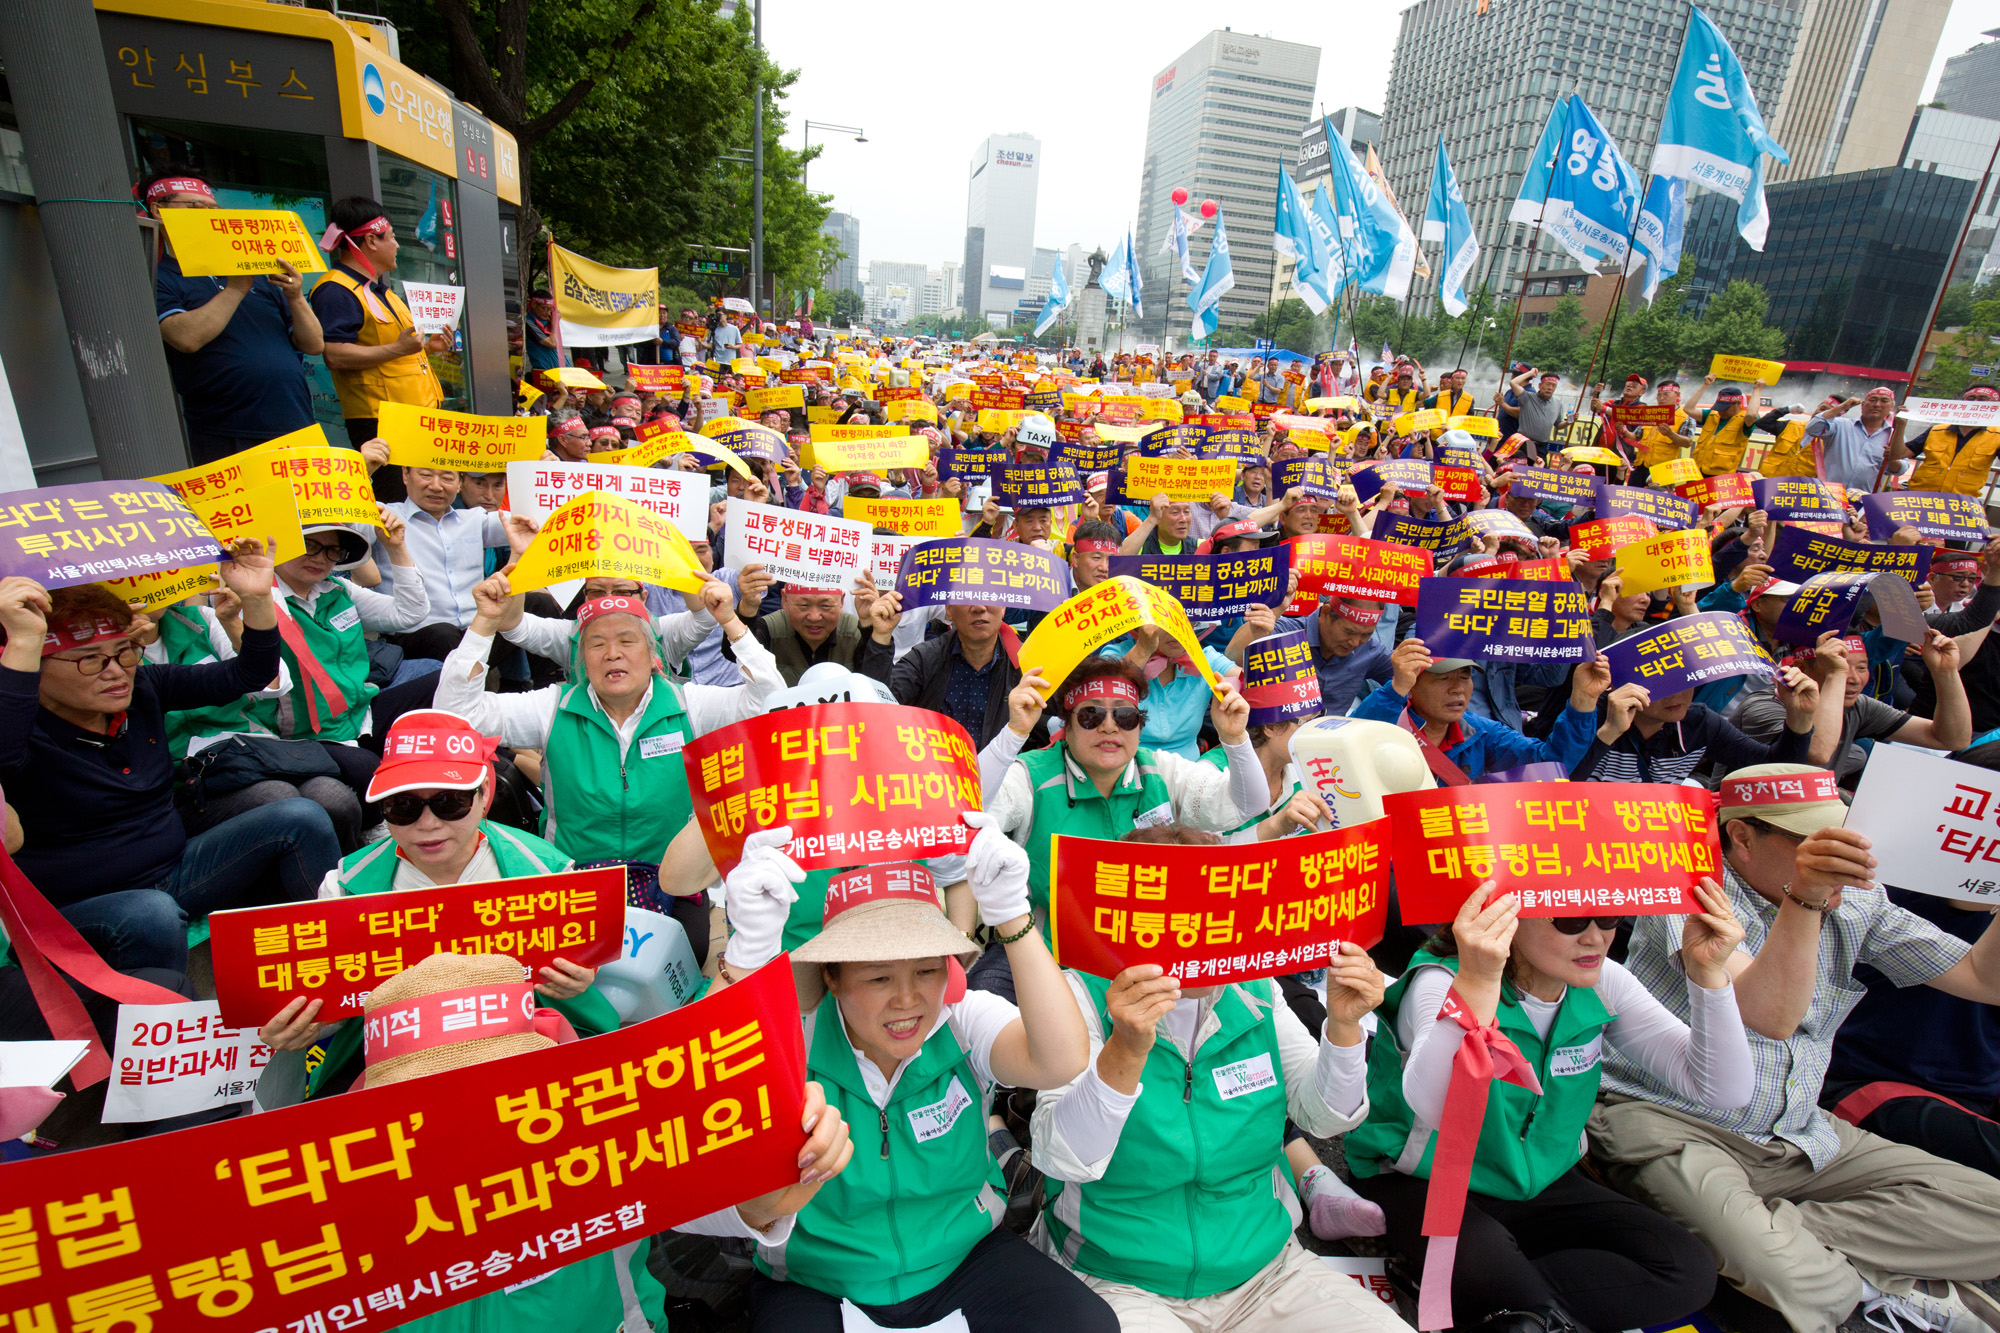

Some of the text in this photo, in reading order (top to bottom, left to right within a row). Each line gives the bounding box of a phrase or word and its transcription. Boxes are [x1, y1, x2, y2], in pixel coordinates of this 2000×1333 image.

[118, 45, 314, 101] 안심부스
[390, 80, 454, 149] 우리은행
[462, 119, 488, 145] 안심부스
[500, 142, 514, 181] kt
[996, 149, 1034, 163] 조선일보
[169, 181, 199, 192] 결단
[209, 218, 287, 235] 대통령까지
[231, 238, 277, 256] 이재용
[754, 389, 779, 399] 대통령까지
[1920, 401, 1967, 411] 교통생태계
[420, 415, 528, 439] 대통령까지 속인
[831, 428, 892, 439] 대통령까지 속인
[1027, 432, 1051, 444] TAXI
[433, 438, 516, 456] 이재용 OUT!
[837, 441, 886, 454] 대통령까지
[1206, 433, 1240, 444] 국민분열
[879, 450, 901, 459] OUT!
[1062, 447, 1095, 459] 국민분열
[271, 457, 365, 480] 대통령까지
[1004, 468, 1046, 481] 국민분열
[1048, 466, 1075, 480] 공유경제
[1139, 462, 1161, 475] 악법
[1163, 463, 1172, 475] 중
[1177, 464, 1198, 476] 악법
[1286, 461, 1324, 475] 국민분열
[1306, 473, 1324, 485] 퇴출
[1527, 469, 1591, 486] 국민분열 공유경제
[534, 472, 682, 498] 교통생태계 교란종
[1027, 483, 1050, 496] 퇴출
[1451, 481, 1468, 492] OUT!
[1542, 482, 1558, 493] 퇴출
[1685, 483, 1707, 497] 불법
[1776, 482, 1818, 495] 국민분열
[867, 504, 944, 518] 대통령까지 속인
[1615, 489, 1690, 511] 국민분열 공유경제
[1801, 496, 1820, 509] 퇴출
[1892, 496, 1946, 511] 국민분열
[210, 503, 254, 530] 속인
[541, 502, 672, 542] 대통령까지 속인
[1637, 502, 1656, 514] 퇴출
[1658, 504, 1692, 524] 그날까지!
[1927, 511, 1950, 526] 퇴출
[16, 516, 215, 559] 투자사기 기업
[744, 511, 861, 548] 교통생태계 교란종
[876, 520, 938, 533] 이재용 OUT!
[1395, 520, 1444, 537] 국민분열
[1577, 526, 1602, 539] 높은
[548, 528, 660, 559] 이재용 OUT!
[1807, 539, 1919, 567] 국민분열 공유경제
[47, 544, 221, 582] 서울개인택시운송사업조합
[808, 547, 859, 569] 박멸하라!
[914, 546, 1051, 572] 국민분열 공유경제
[1295, 541, 1326, 556] 불법
[1379, 549, 1426, 571] 방관하는
[1661, 552, 1705, 570] 이재용
[546, 559, 662, 580] 서울개인택시운송사업조합
[1140, 556, 1274, 581] 국민분열 공유경제
[1297, 558, 1355, 582] 대통령님,
[948, 567, 984, 586] 퇴출
[990, 569, 1061, 595] 그날까지!
[1180, 576, 1279, 602] 퇴출 그날까지!
[1322, 582, 1398, 600] 서울개인택시운송사업조합
[600, 597, 629, 610] GO
[930, 591, 1032, 606] 서울개인택시운송사업조합
[1054, 580, 1162, 629] 대통령까지
[1459, 588, 1548, 612] 국민분열
[1076, 598, 1143, 631] 이재용
[1507, 617, 1549, 639] 퇴출
[1636, 620, 1721, 656] 국민분열
[1694, 639, 1736, 660] 퇴출
[1066, 680, 1138, 705] 정치적 결단
[395, 734, 475, 756] 결단 GO
[700, 743, 746, 793] 불법
[896, 726, 979, 777] 방관하는
[1734, 779, 1805, 803] 정치적
[710, 777, 834, 838] 대통령님,
[1419, 802, 1490, 839] 불법
[1614, 800, 1708, 834] 방관하는
[1094, 860, 1168, 901] 불법
[1300, 841, 1379, 889] 방관하는
[1427, 840, 1715, 880] 대통령님, 사과하세요!
[885, 869, 931, 895] 결단
[253, 918, 328, 957] 불법
[474, 888, 598, 927] 방관하는
[1093, 881, 1377, 949] 대통령님, 사과하세요!
[257, 946, 414, 992] 대통령님,
[1167, 939, 1341, 980] 서울개인택시운송사업조합
[441, 993, 509, 1033] 결단
[120, 1045, 238, 1087] 일반과세
[495, 1019, 766, 1145] 방관하는
[405, 1084, 773, 1247] 사과하세요!
